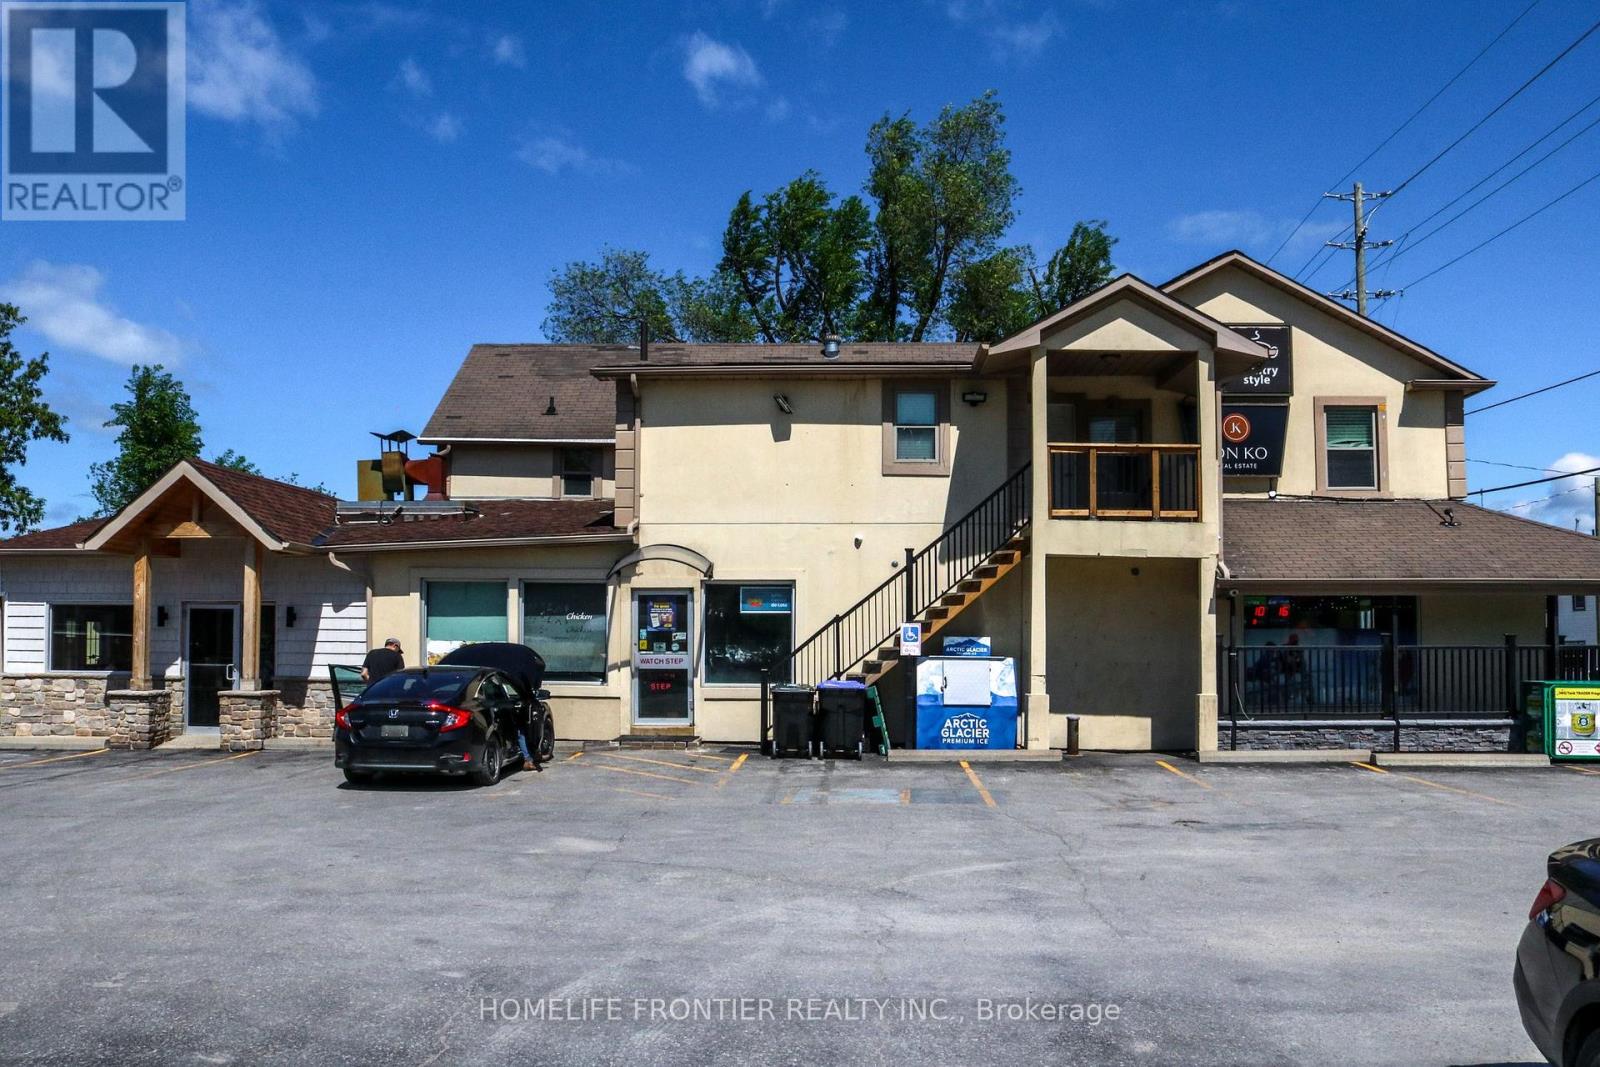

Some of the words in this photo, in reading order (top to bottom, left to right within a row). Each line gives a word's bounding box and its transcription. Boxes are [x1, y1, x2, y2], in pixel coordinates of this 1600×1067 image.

[1243, 375, 1271, 386] style
[1244, 446, 1268, 460] KO
[566, 612, 593, 620] Chicken
[943, 719, 987, 729] ARCTIC
[941, 728, 990, 738] GLACIER
